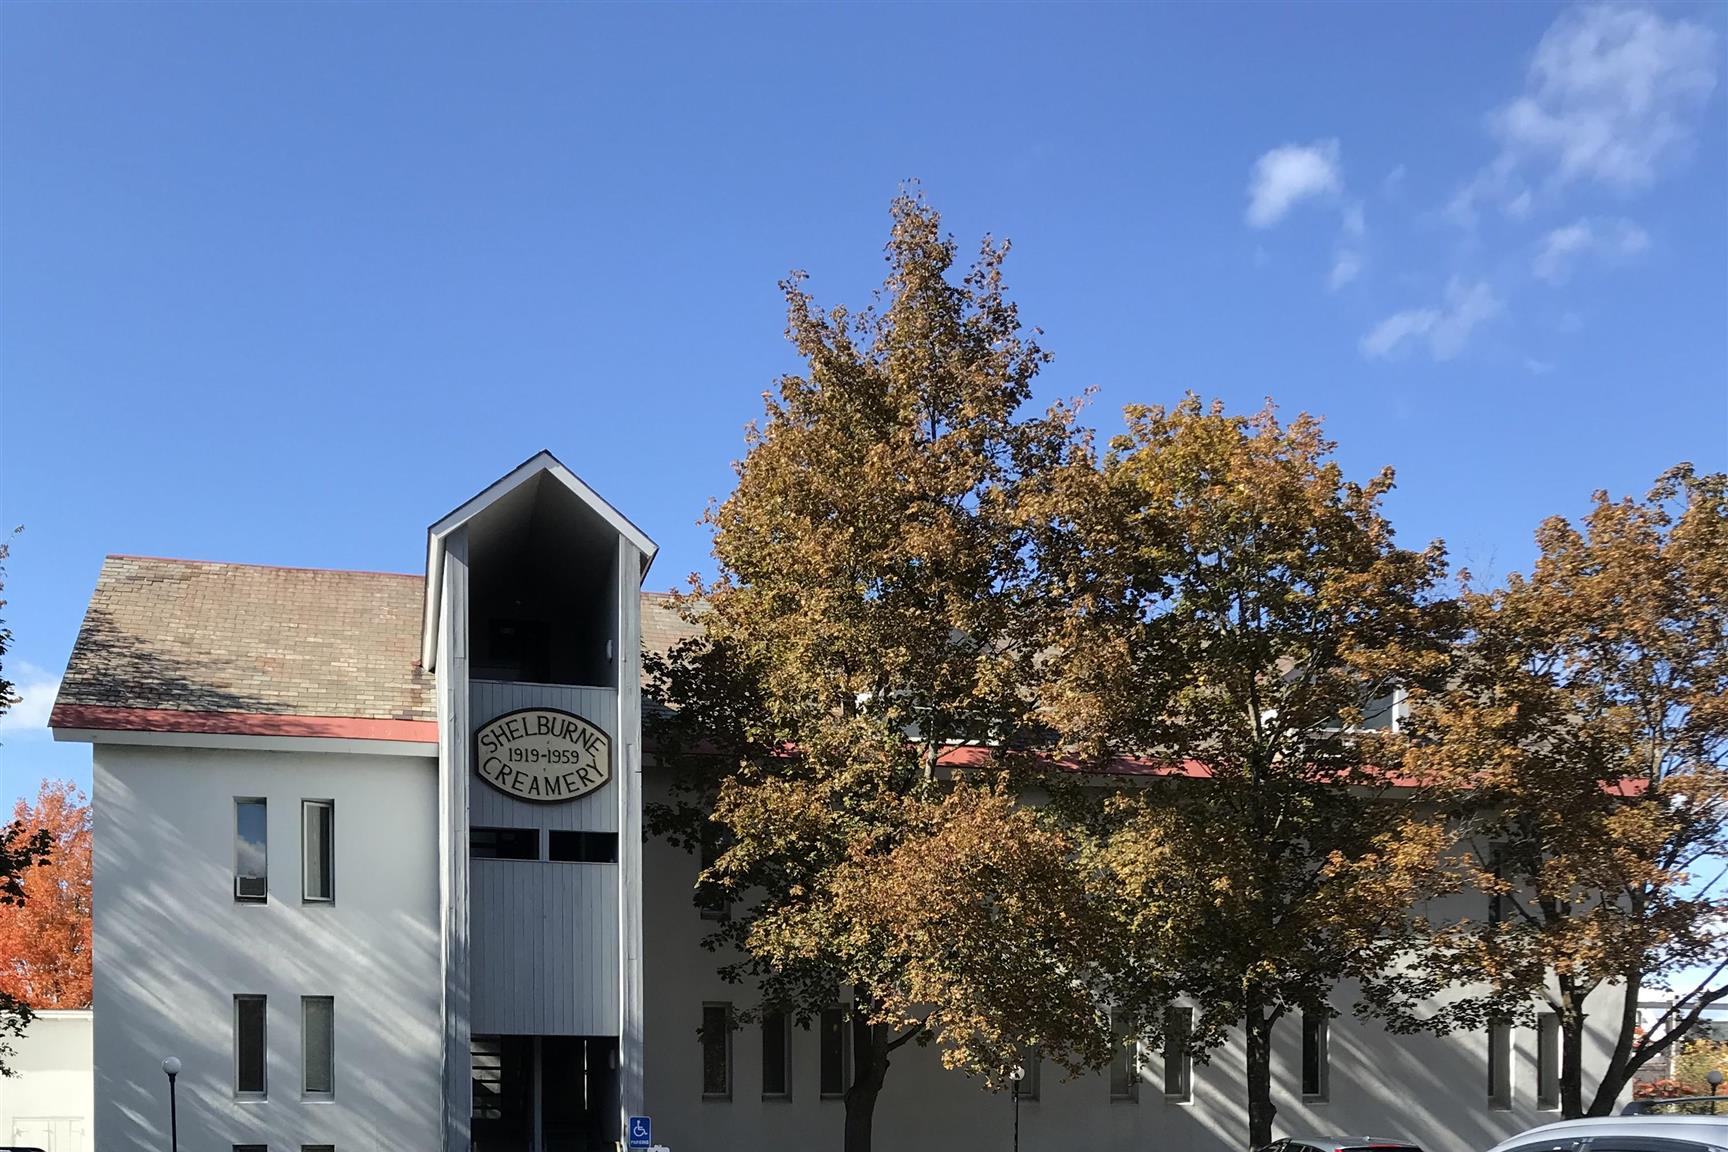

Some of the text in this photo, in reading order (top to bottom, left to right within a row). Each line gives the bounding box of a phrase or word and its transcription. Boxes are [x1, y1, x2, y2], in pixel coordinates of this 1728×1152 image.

[480, 715, 606, 758] SHELBURNE
[508, 747, 579, 764] 1919-1959
[483, 756, 604, 796] CREAMERY
